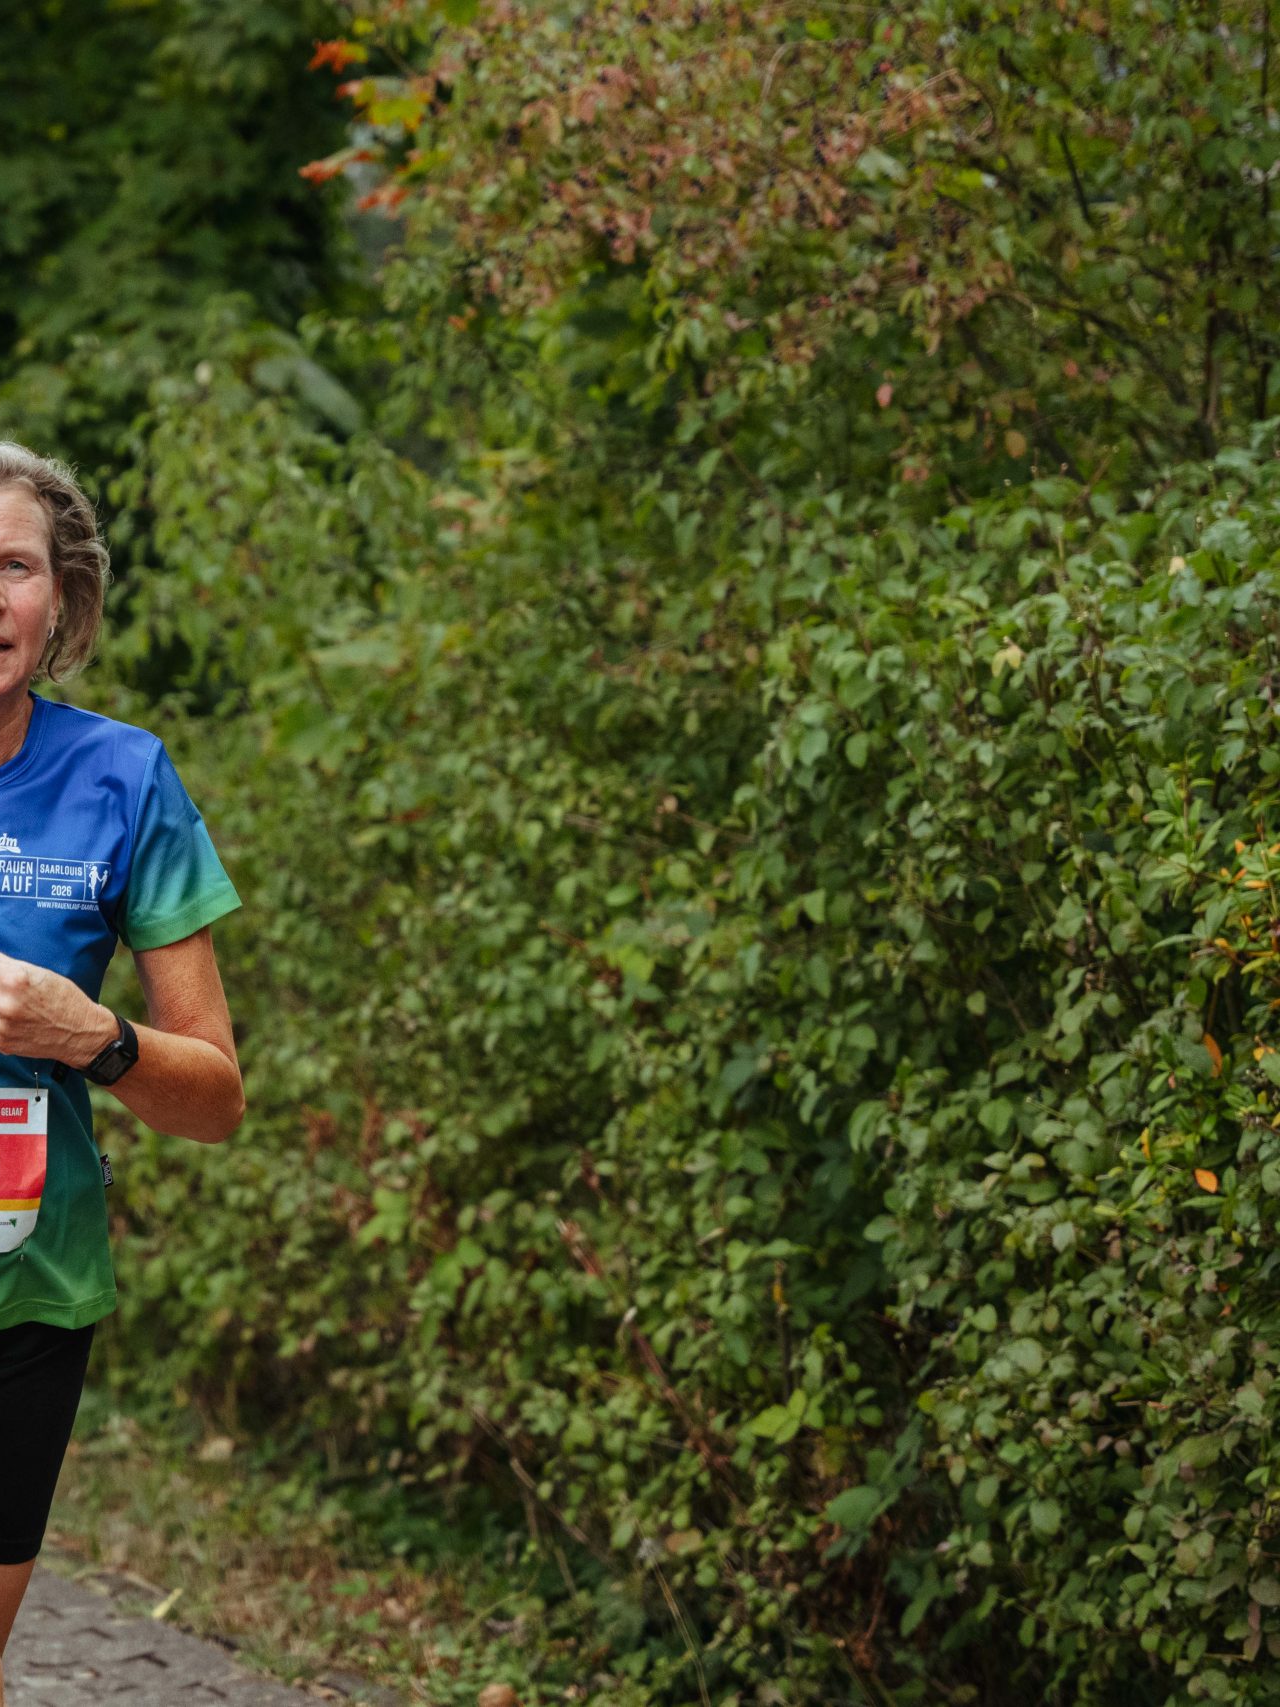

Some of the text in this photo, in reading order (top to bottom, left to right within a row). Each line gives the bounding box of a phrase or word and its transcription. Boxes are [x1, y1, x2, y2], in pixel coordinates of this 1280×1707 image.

[39, 863, 83, 876] SAARLOUIS
[51, 885, 72, 896] 2026
[1, 1107, 24, 1117] GELAAF
